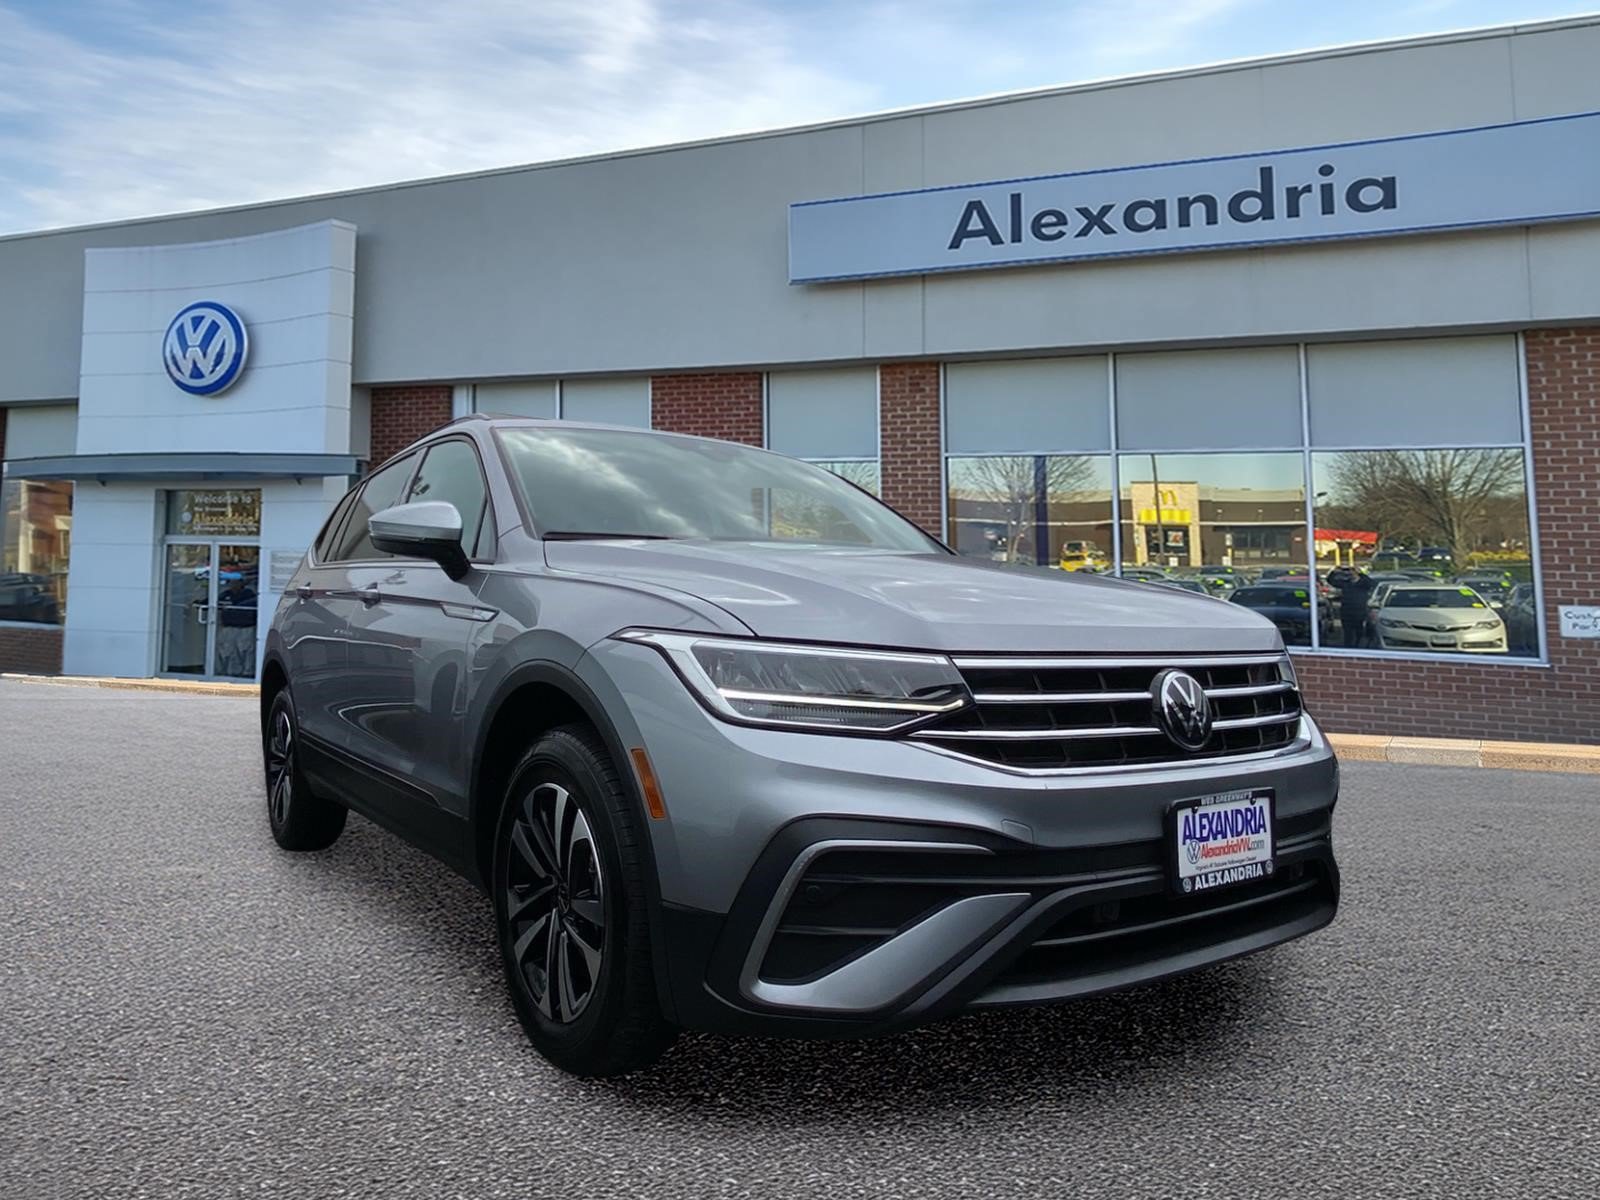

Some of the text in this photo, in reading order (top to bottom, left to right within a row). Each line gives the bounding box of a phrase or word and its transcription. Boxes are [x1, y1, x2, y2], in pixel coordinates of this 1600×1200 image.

[947, 163, 1397, 250] Alexandria
[194, 495, 239, 504] Welcome
[1182, 805, 1266, 845] ALEXANDRIA
[1194, 863, 1263, 890] ALEXANDRIA
